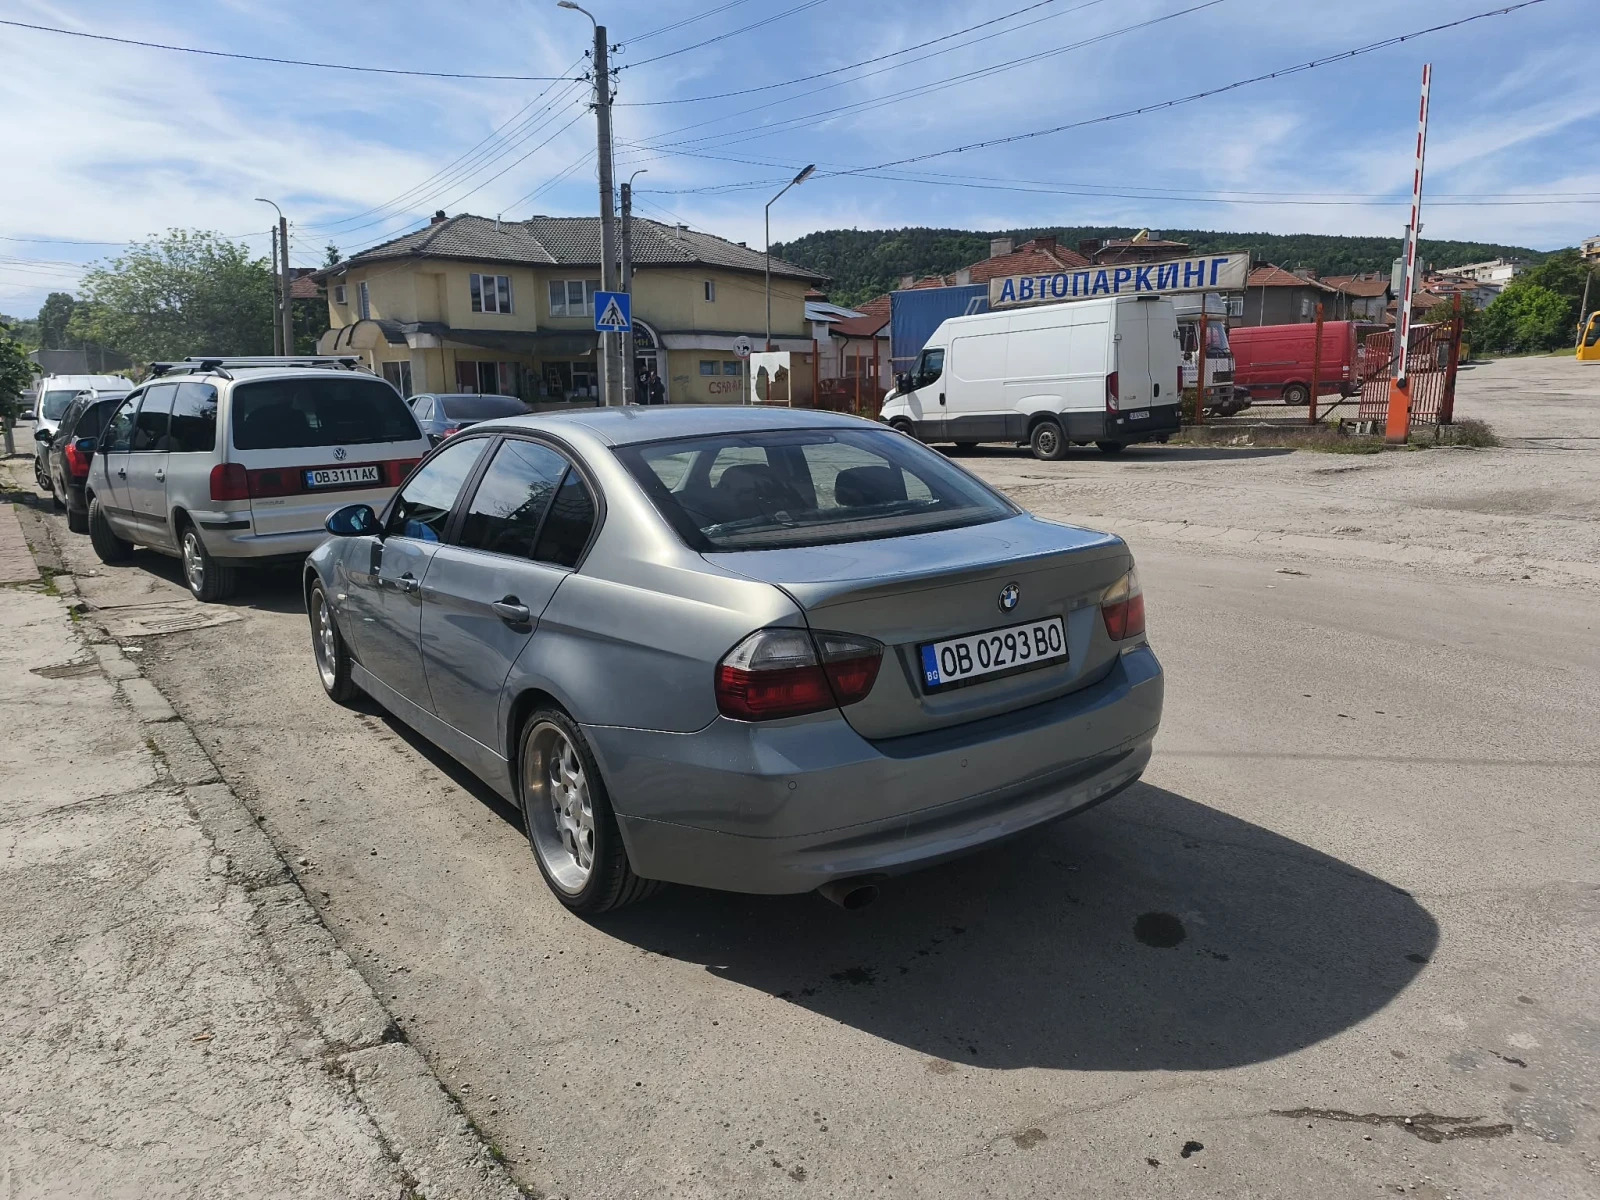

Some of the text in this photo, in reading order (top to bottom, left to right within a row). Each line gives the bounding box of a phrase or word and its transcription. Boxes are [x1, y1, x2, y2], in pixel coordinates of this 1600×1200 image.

[1000, 258, 1229, 303] АВТОПАРКИНГ
[314, 467, 376, 484] OB 3111 AK
[940, 624, 1062, 677] OB 0293 BO
[926, 670, 939, 681] BG
